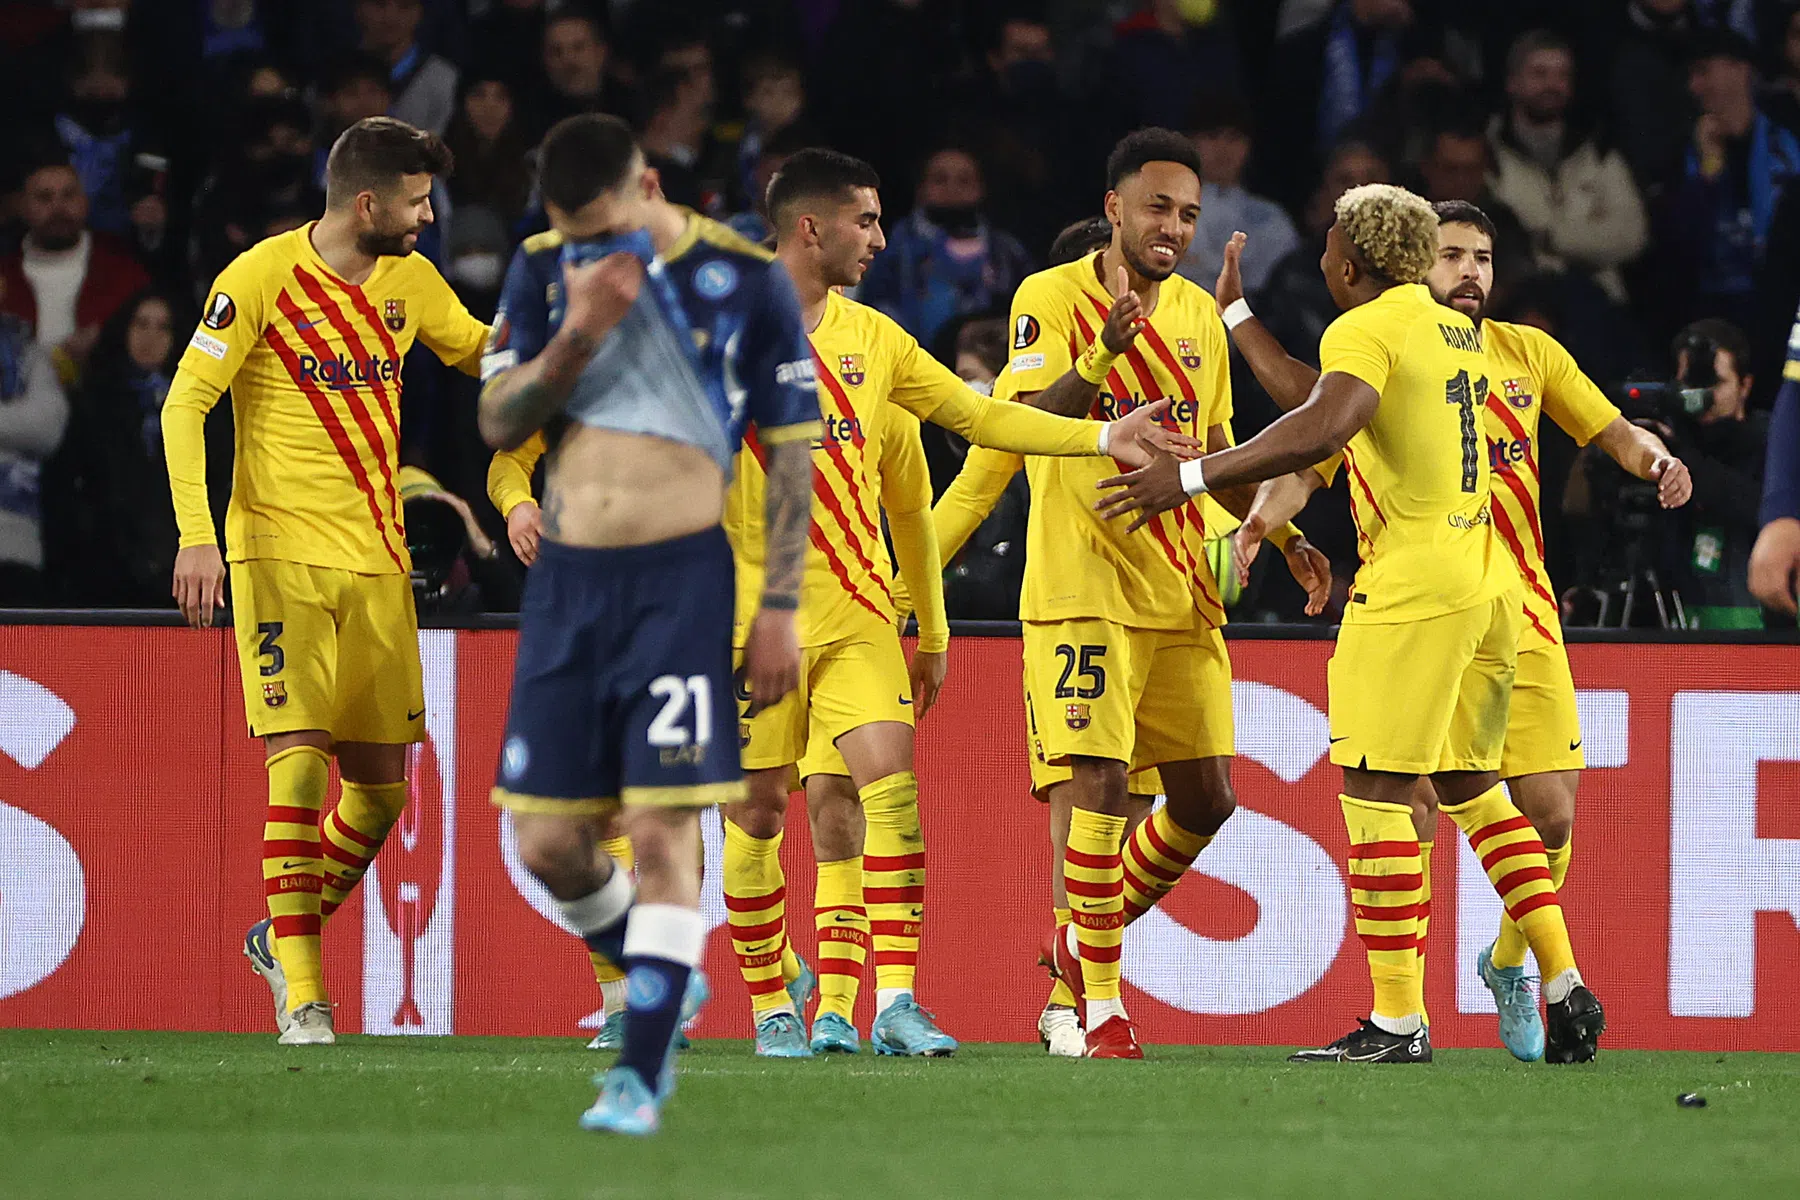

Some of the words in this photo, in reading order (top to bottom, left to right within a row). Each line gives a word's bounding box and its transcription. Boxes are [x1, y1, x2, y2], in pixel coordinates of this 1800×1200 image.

[827, 414, 863, 441] ten
[258, 622, 284, 676] 3
[1055, 644, 1107, 699] 25
[647, 674, 710, 746] 21
[1080, 915, 1119, 928] BARÇA
